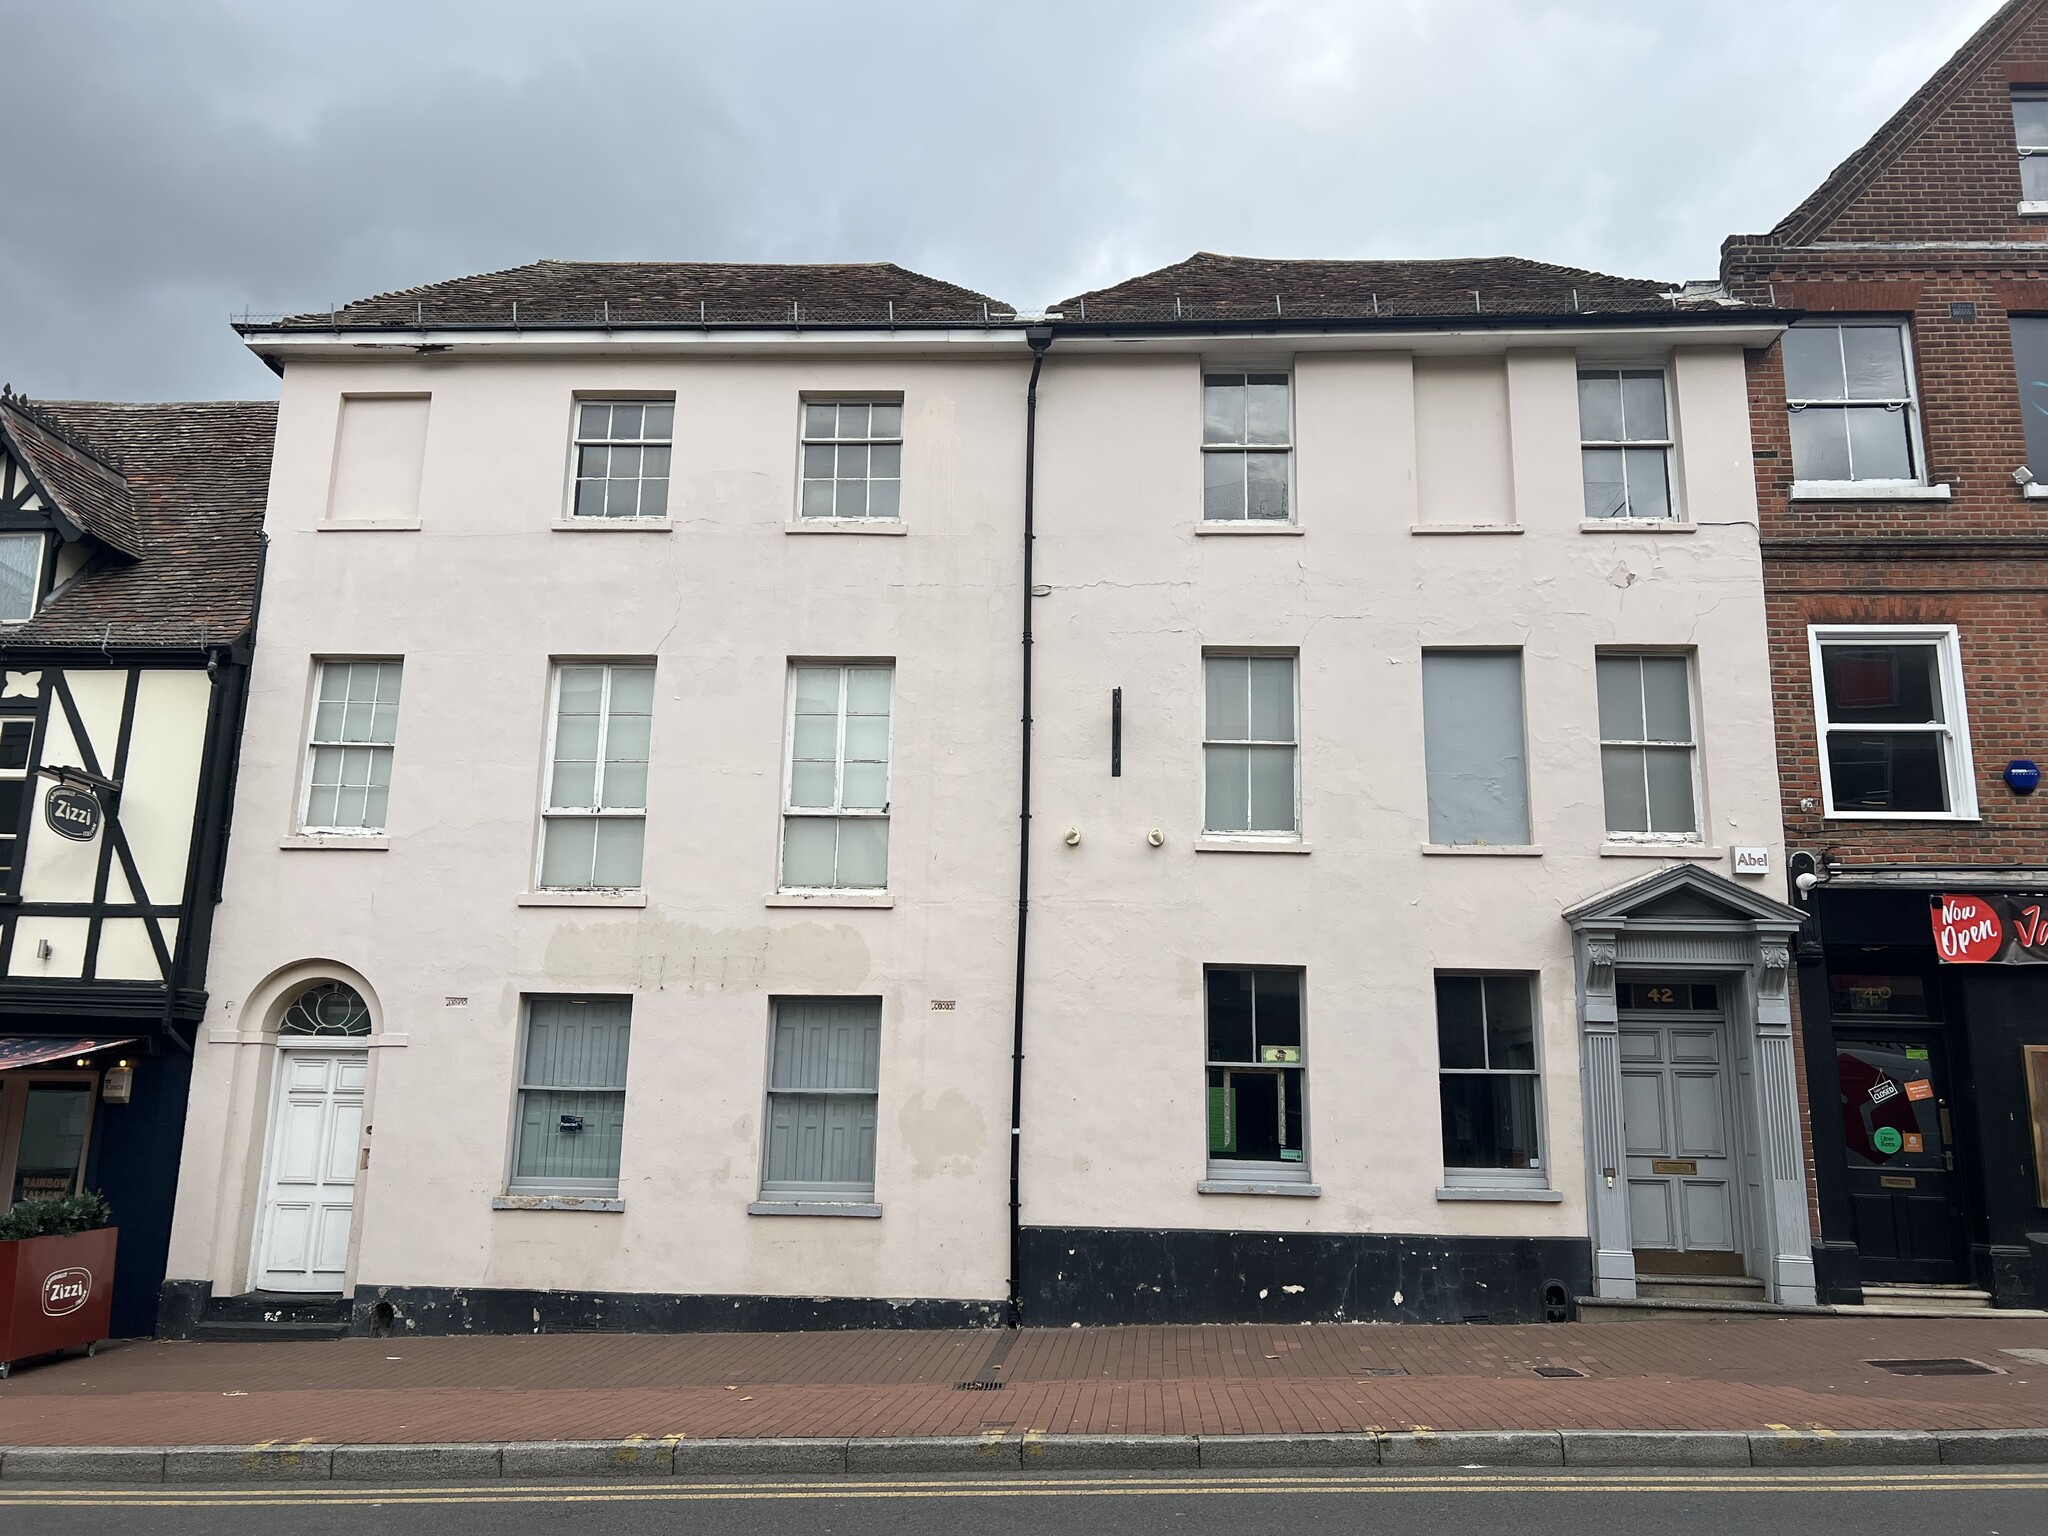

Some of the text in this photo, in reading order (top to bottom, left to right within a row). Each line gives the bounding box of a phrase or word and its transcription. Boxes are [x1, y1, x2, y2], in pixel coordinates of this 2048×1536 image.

[55, 799, 91, 826] Zizzi
[1737, 853, 1768, 867] Abel
[1942, 900, 1976, 925] Now
[1941, 919, 1998, 957] Open
[1647, 987, 1674, 1003] 42
[1873, 1086, 1895, 1101] CLOSED
[23, 1177, 71, 1189] RAINBOW
[50, 1280, 83, 1302] Zizzi
